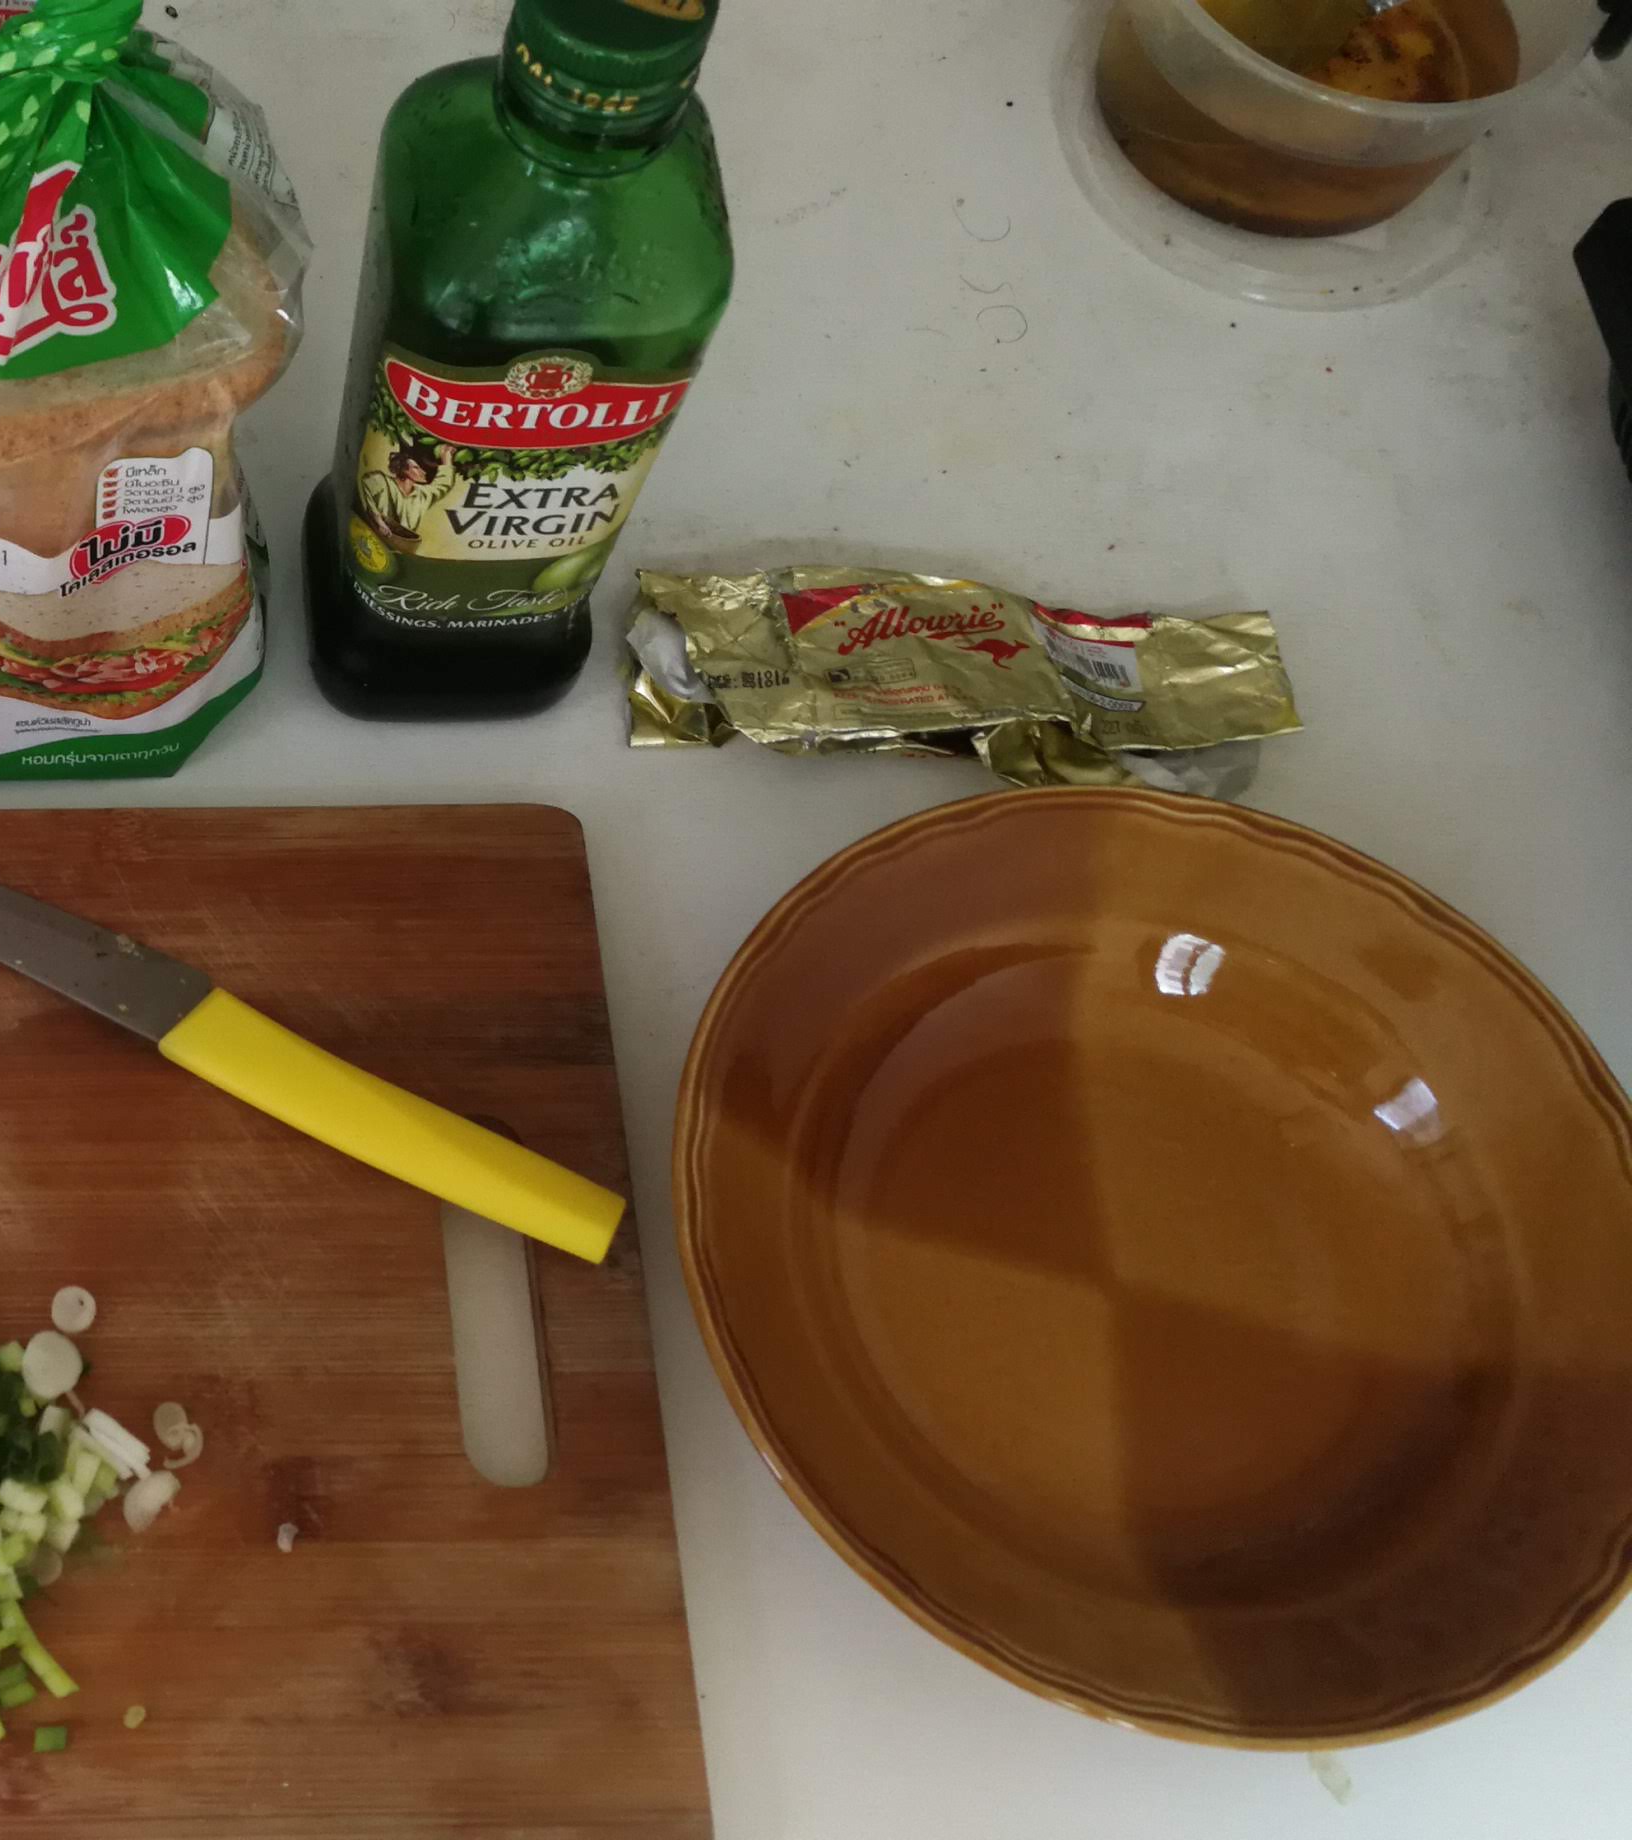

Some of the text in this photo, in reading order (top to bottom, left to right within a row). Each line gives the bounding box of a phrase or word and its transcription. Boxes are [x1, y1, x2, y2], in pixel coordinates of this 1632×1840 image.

[403, 376, 674, 431] BERTOLLI
[463, 482, 621, 511] EXTRA
[444, 502, 623, 538] VIRGIN
[468, 534, 588, 550] OLIVE OIL
[373, 585, 461, 612] Rich
